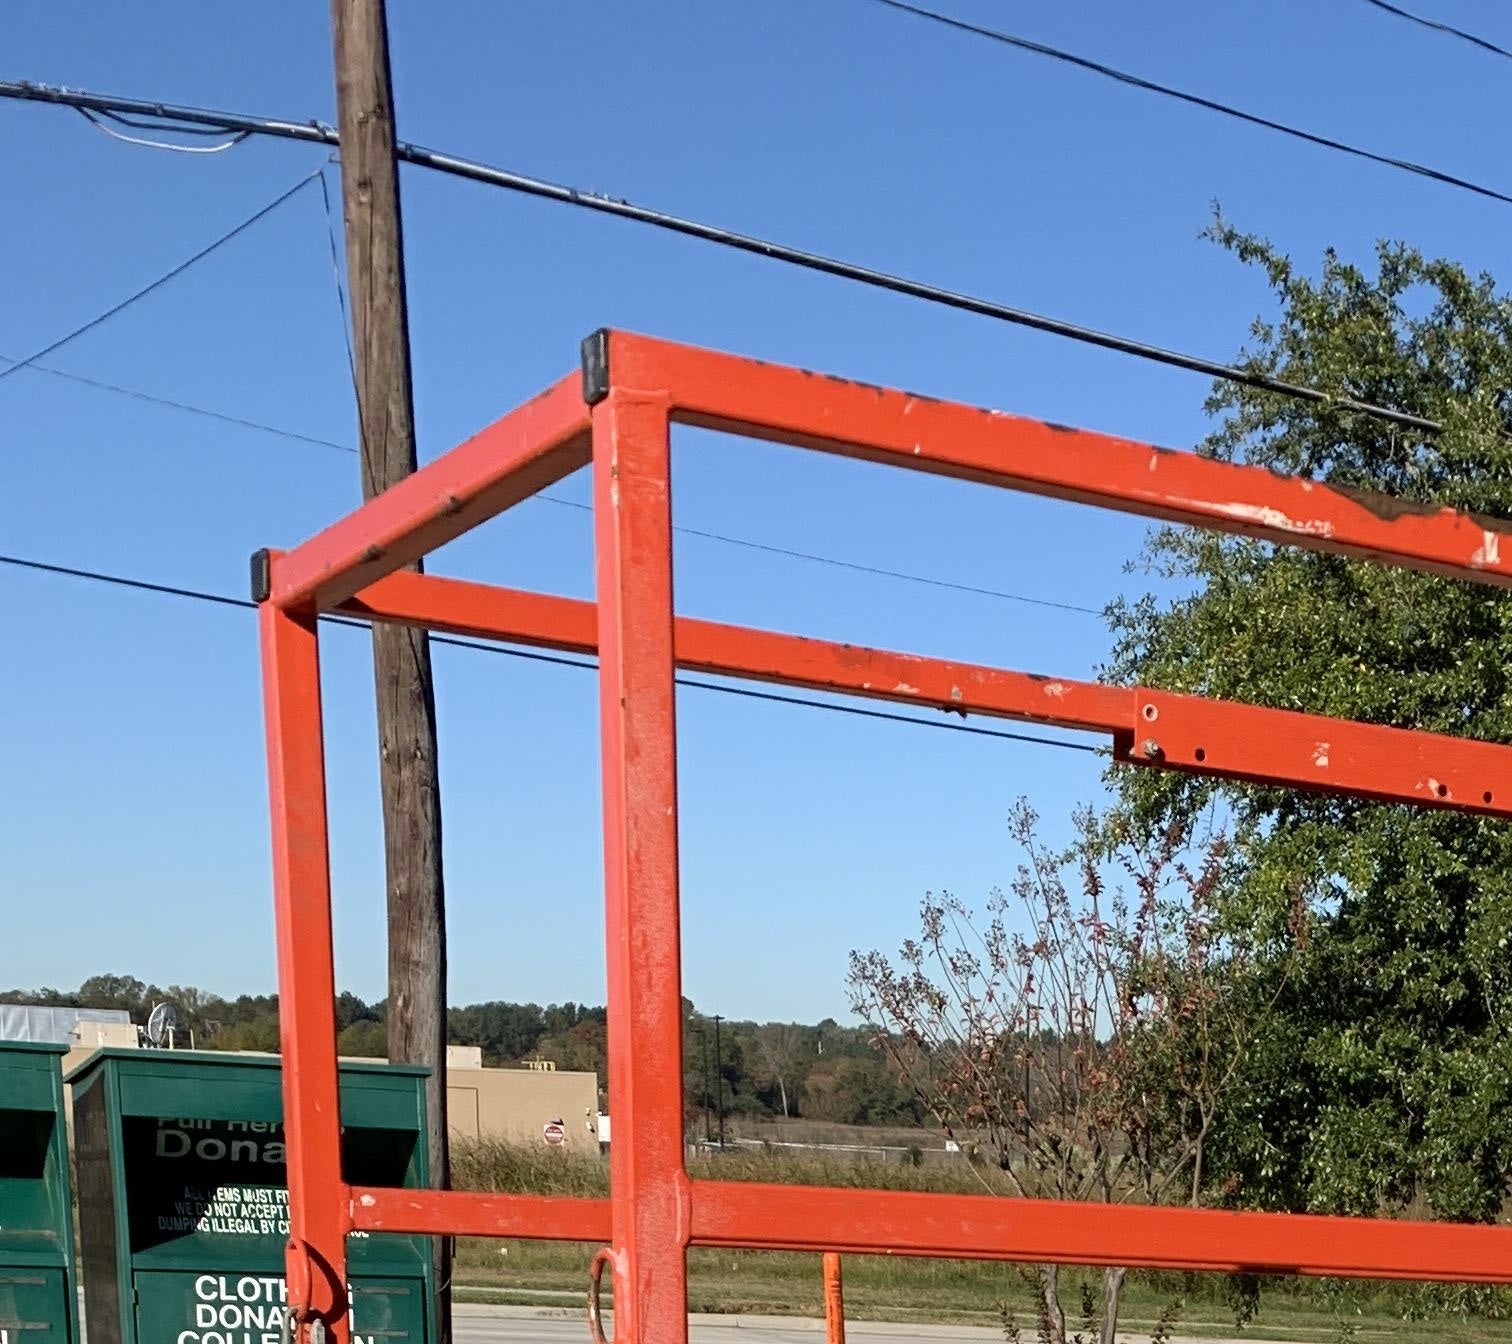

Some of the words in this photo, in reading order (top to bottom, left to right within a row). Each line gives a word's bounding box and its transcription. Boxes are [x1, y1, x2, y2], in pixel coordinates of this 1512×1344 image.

[156, 1129, 287, 1164] Dona
[242, 1188, 273, 1203] MUST
[214, 1203, 238, 1218] NOT
[242, 1204, 284, 1219] ACCEPT
[211, 1217, 259, 1234] ILLEGAL
[261, 1218, 276, 1234] BY
